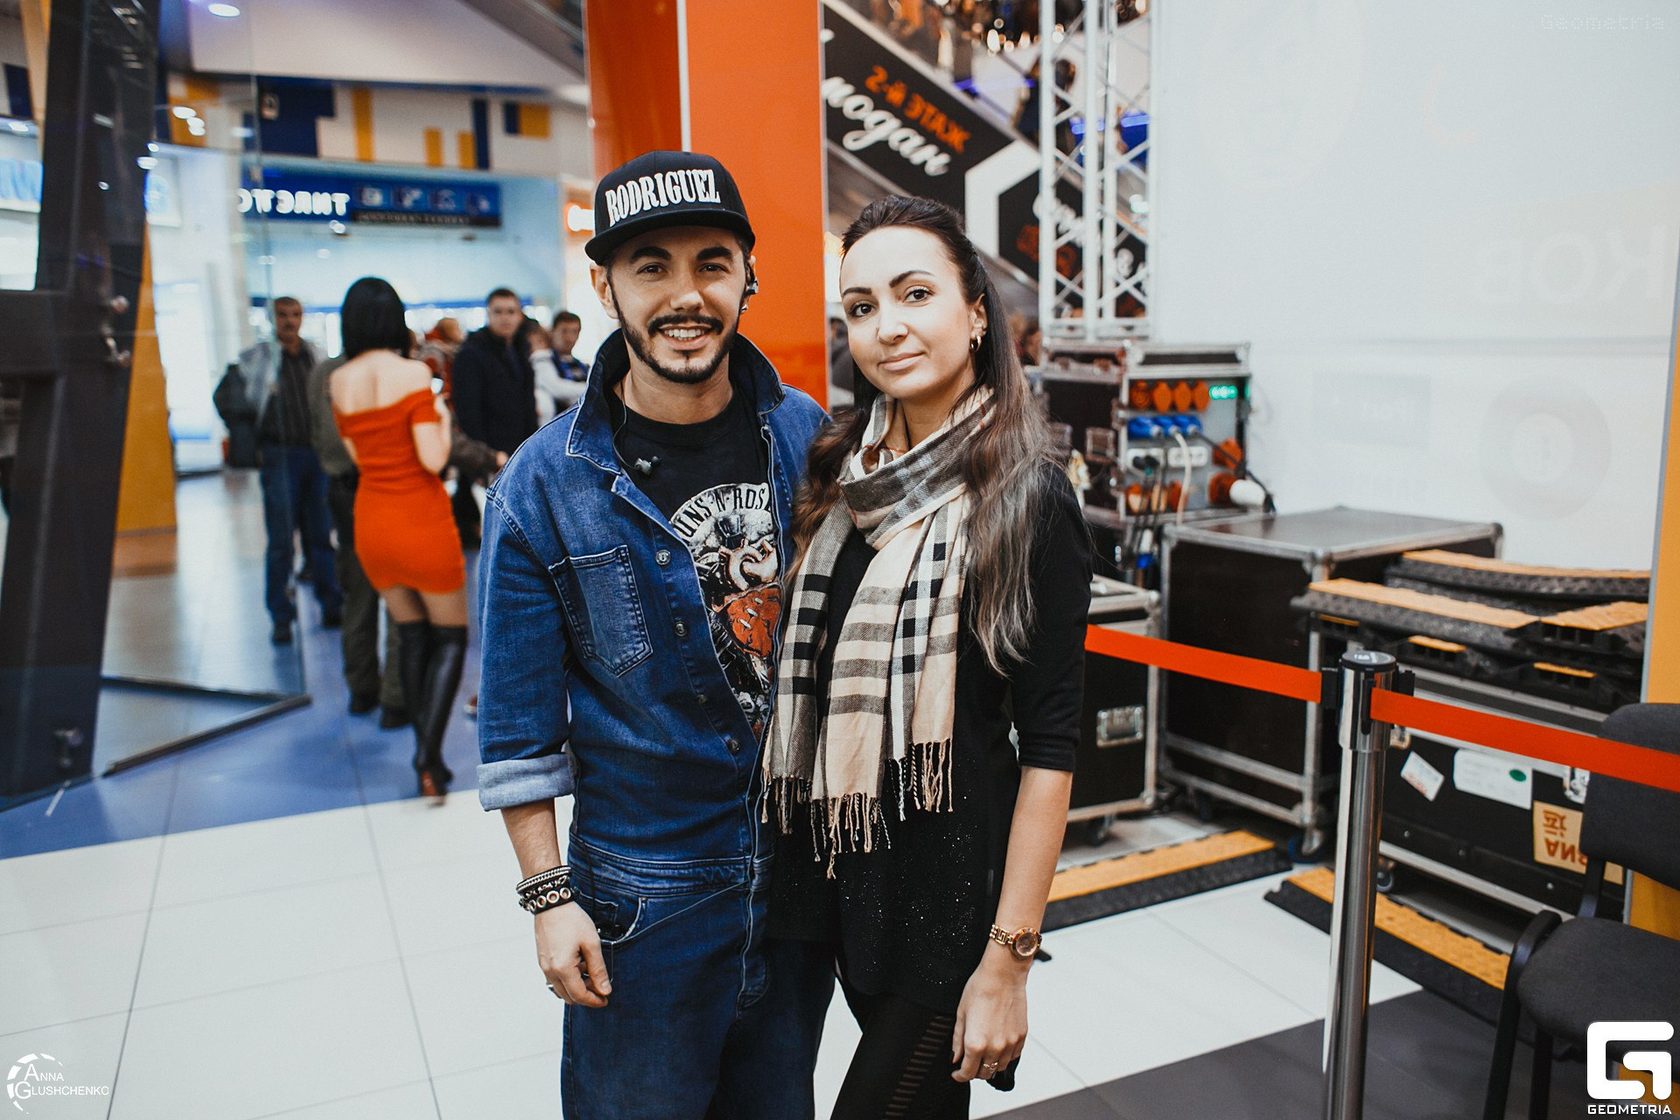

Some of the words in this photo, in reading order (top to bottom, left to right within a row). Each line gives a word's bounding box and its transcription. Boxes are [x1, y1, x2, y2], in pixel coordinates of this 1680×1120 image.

[605, 169, 721, 227] RODRIGUEZ
[672, 497, 712, 541] UNS
[733, 487, 770, 511] ROS
